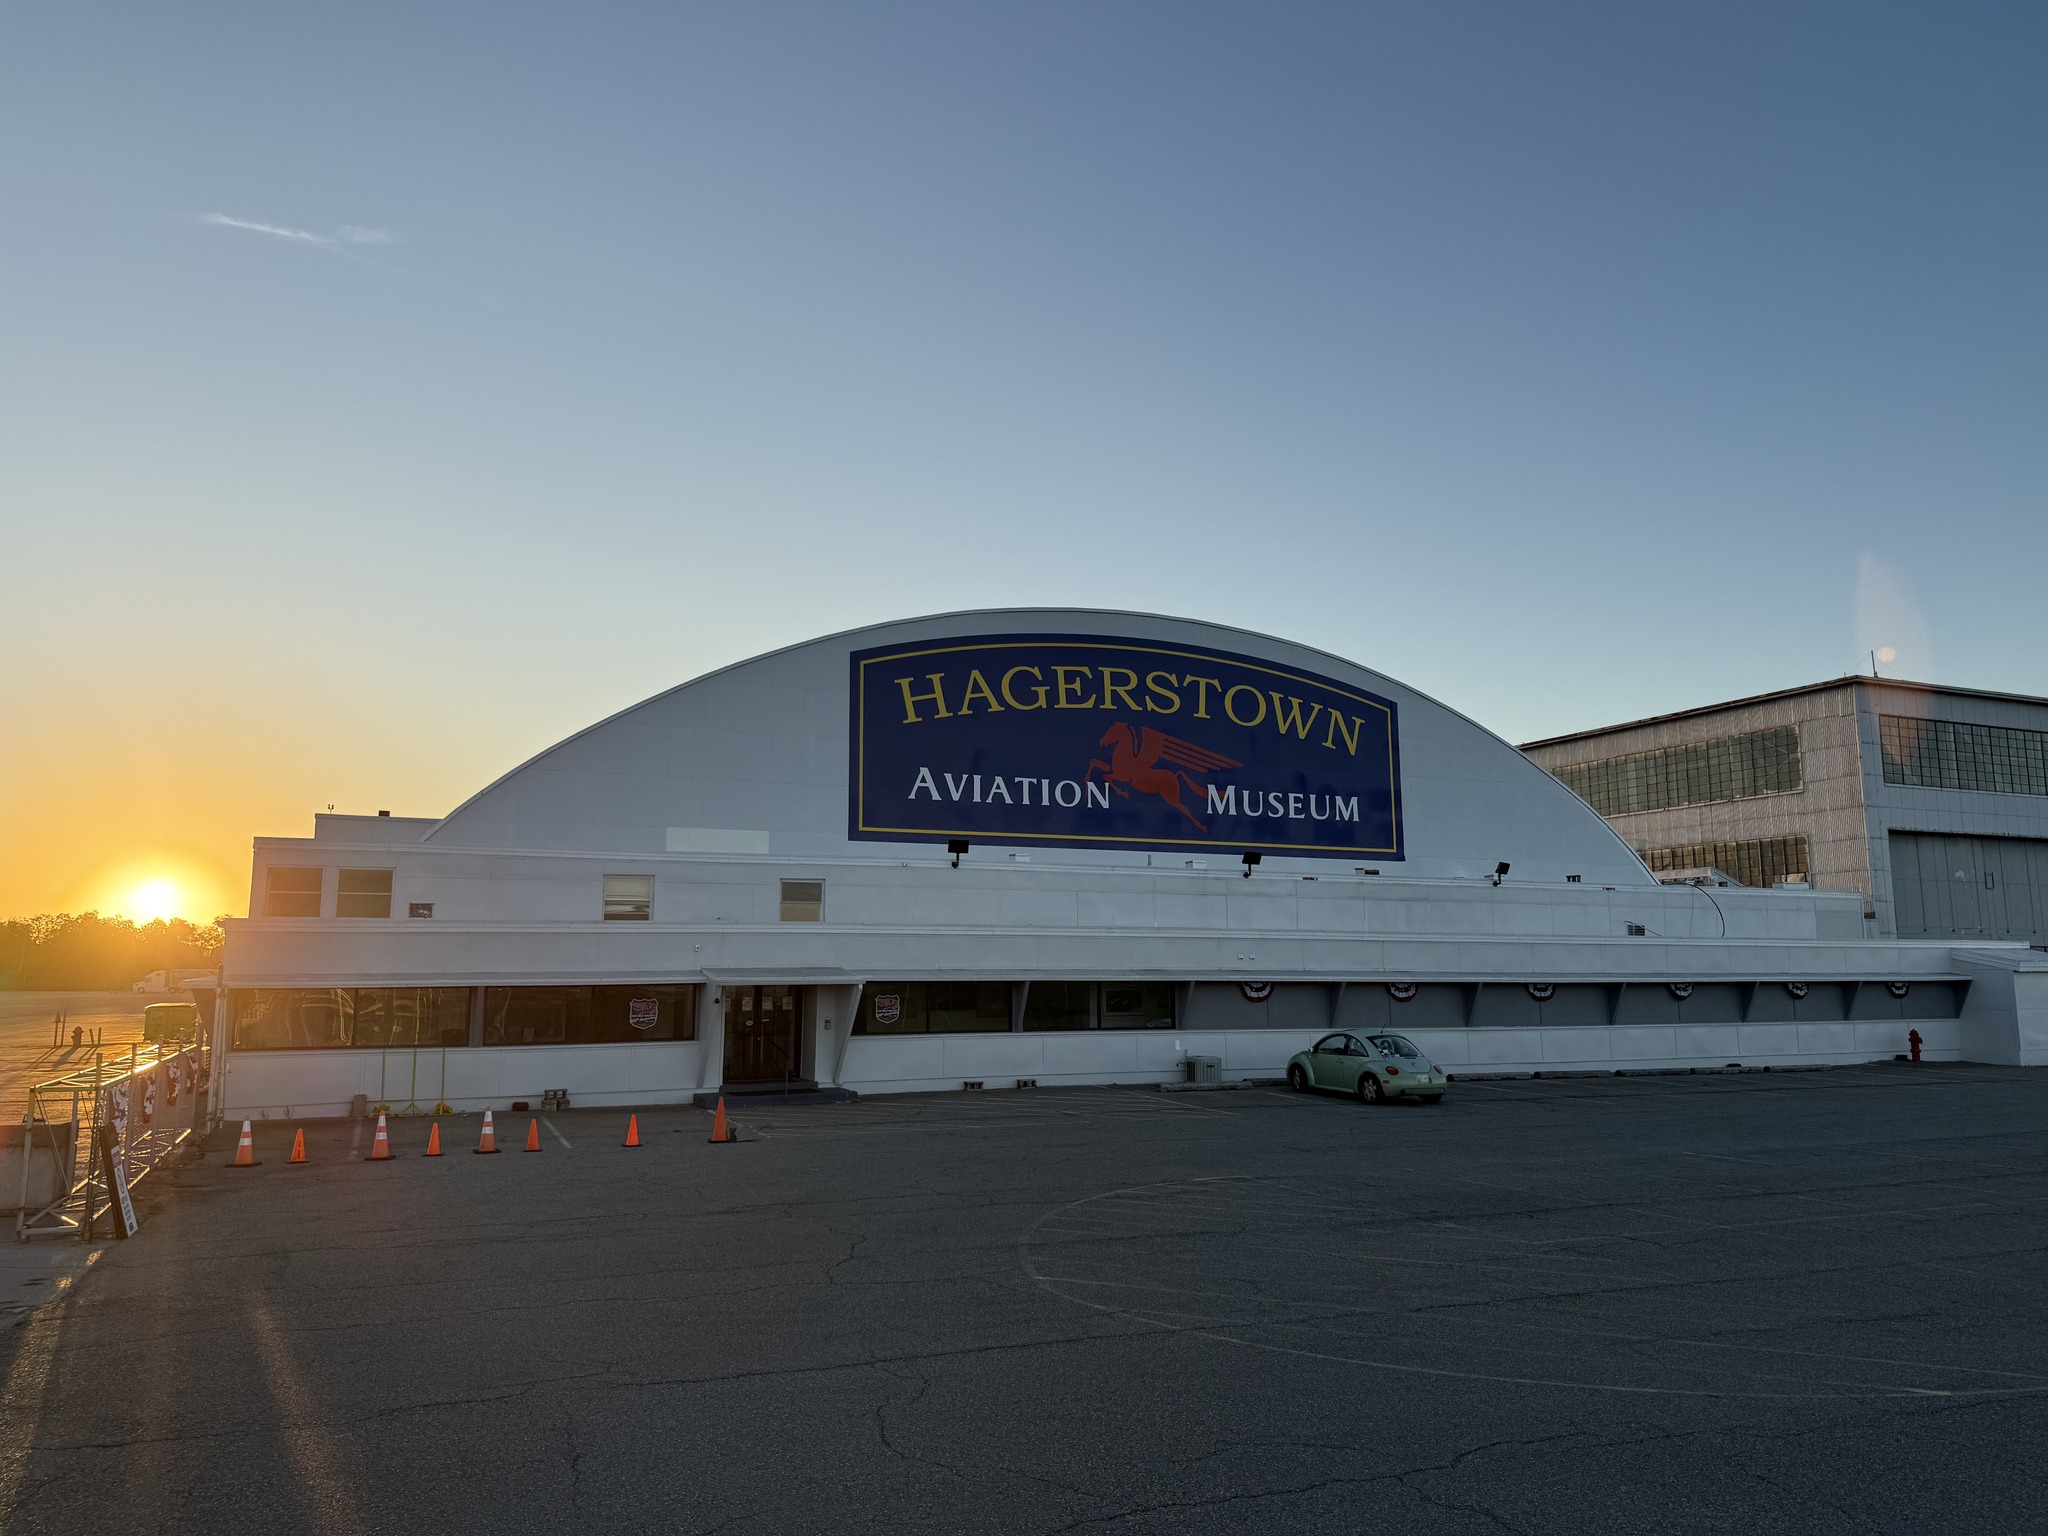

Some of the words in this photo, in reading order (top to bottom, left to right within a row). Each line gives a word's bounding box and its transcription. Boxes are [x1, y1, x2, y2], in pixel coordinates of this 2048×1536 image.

[895, 665, 1365, 756] HAGERSTOWN
[907, 766, 1110, 809] AVIATION
[1206, 784, 1360, 822] MUSEUM
